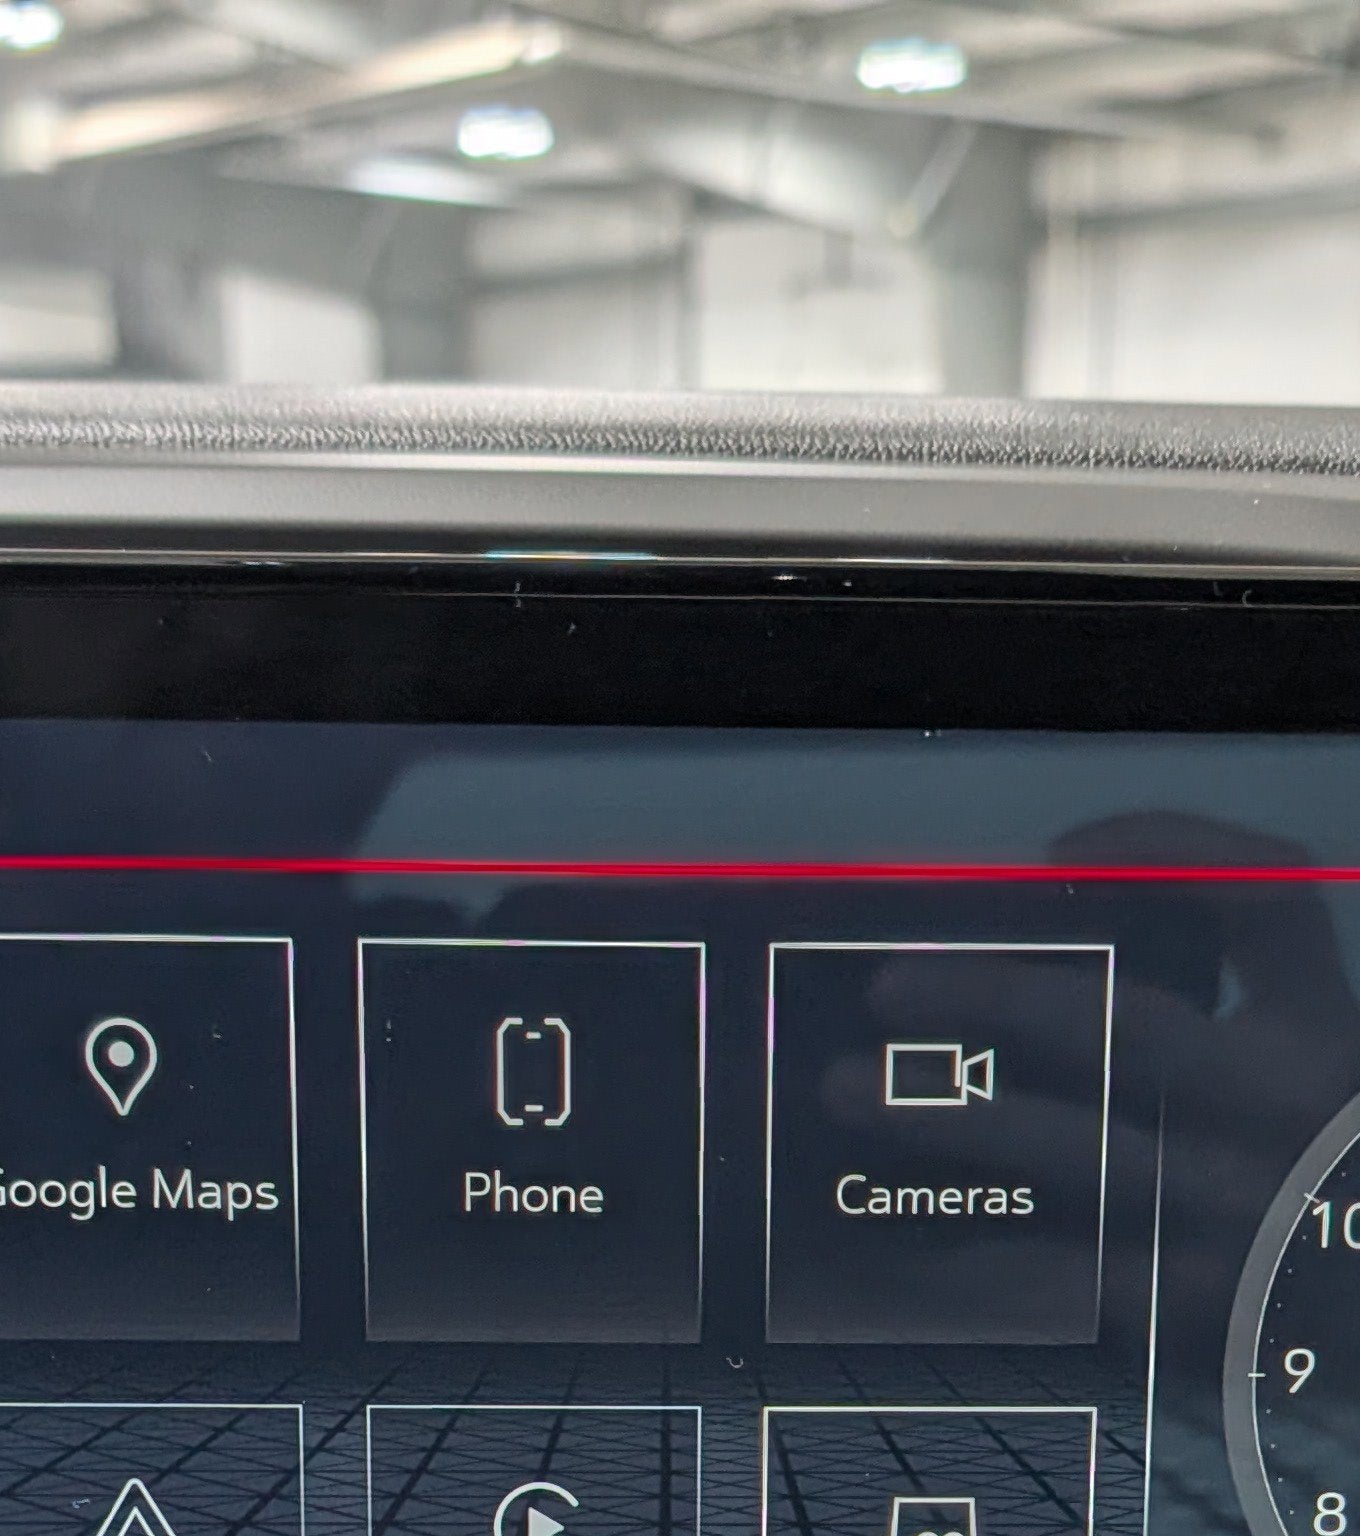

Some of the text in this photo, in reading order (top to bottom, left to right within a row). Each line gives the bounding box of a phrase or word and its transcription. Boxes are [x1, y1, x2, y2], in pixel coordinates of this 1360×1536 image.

[152, 1167, 280, 1223] Maps
[463, 1168, 605, 1214] Phone
[835, 1173, 1036, 1216] Cameras
[1283, 1347, 1316, 1395] 9
